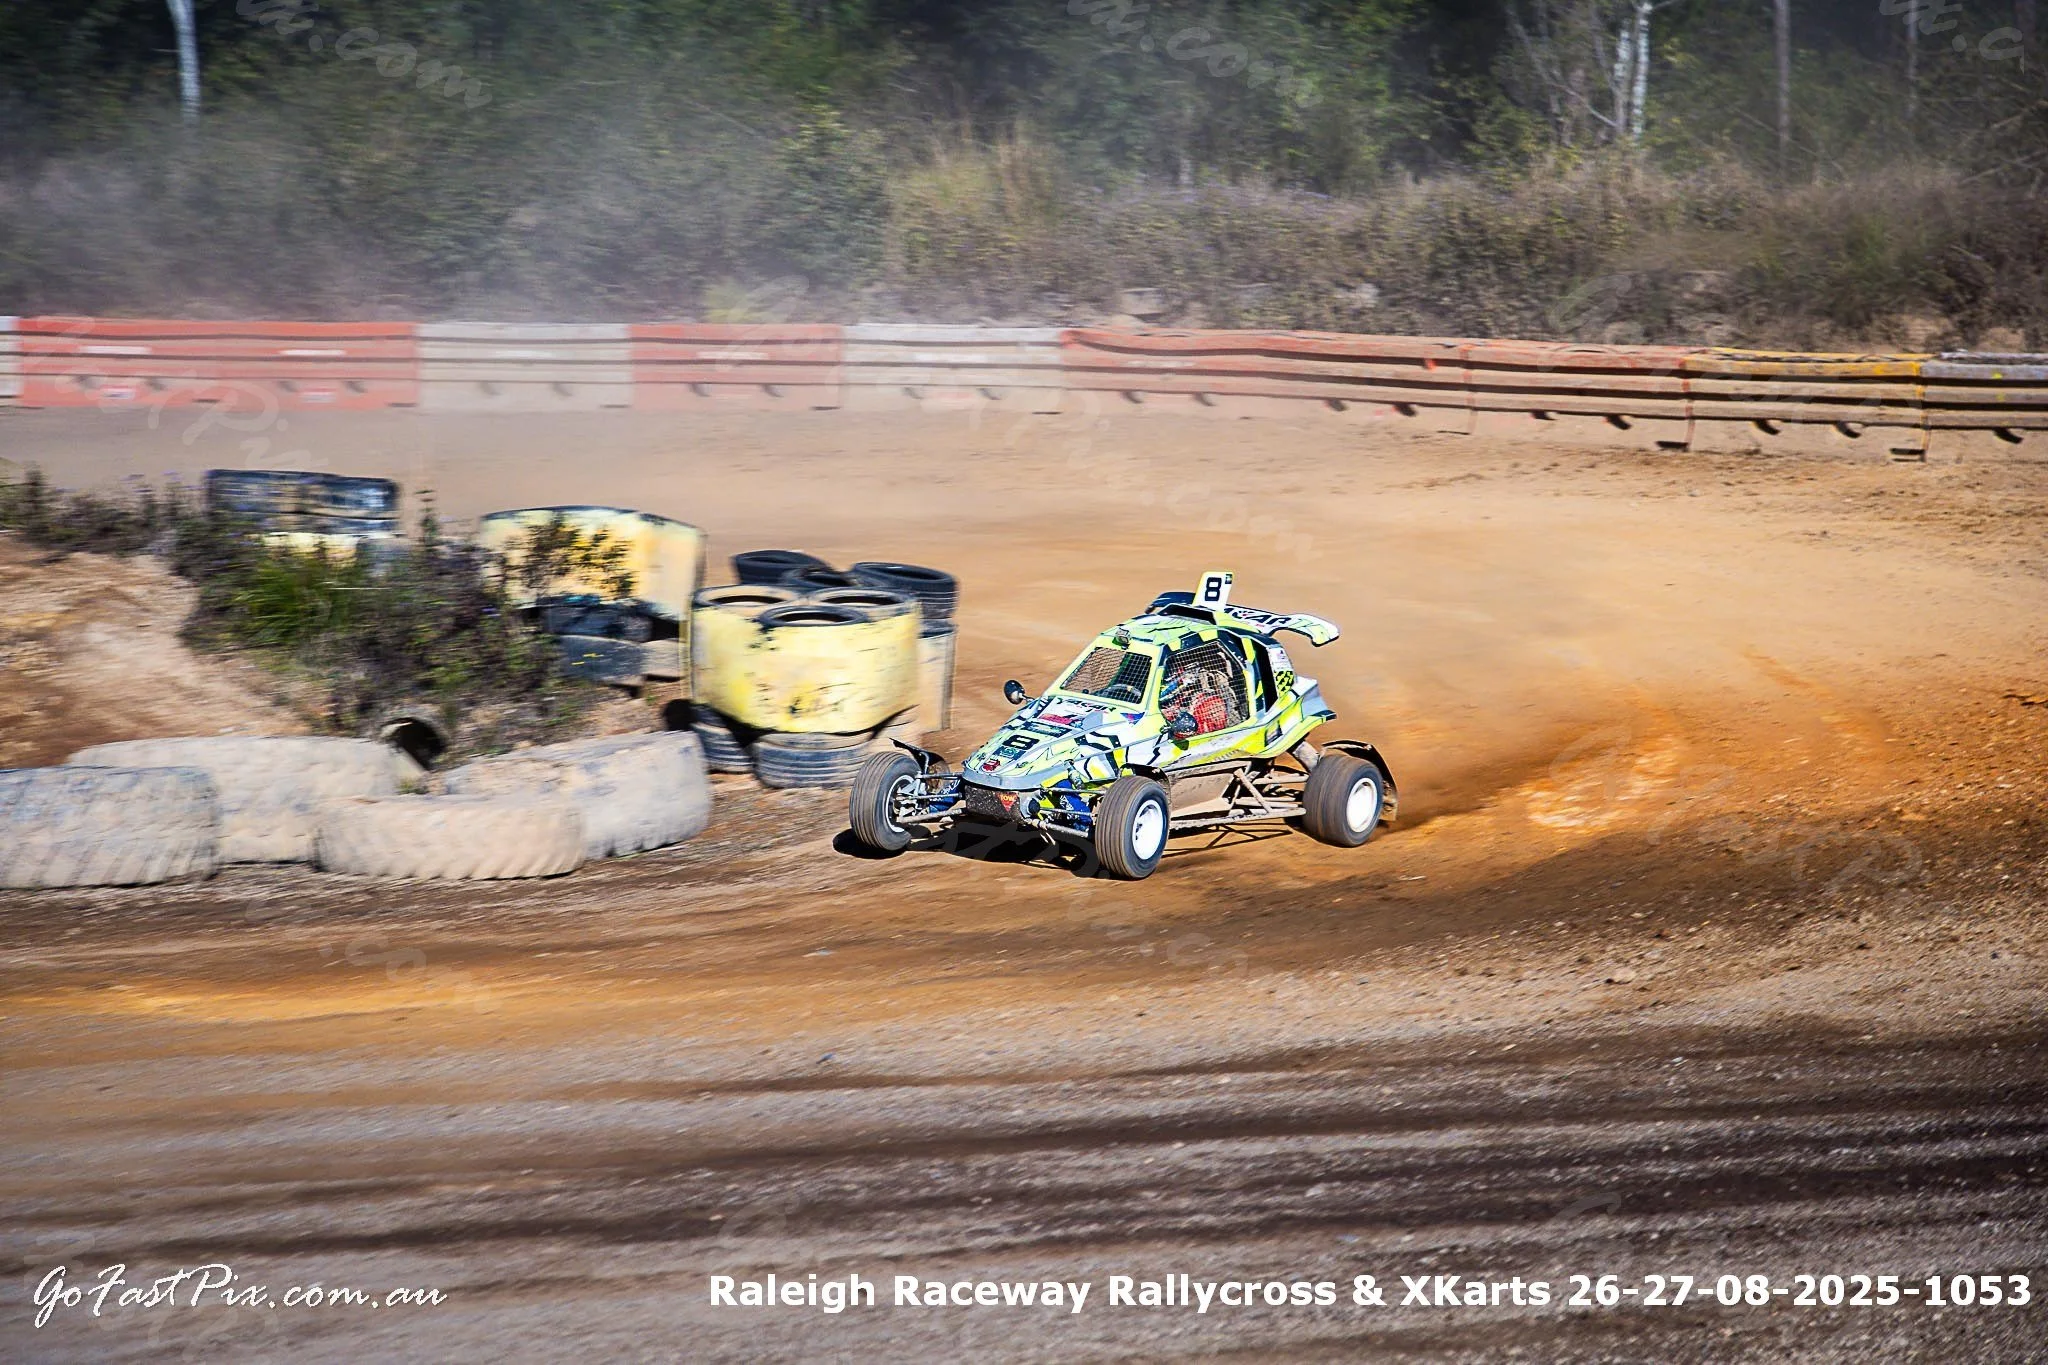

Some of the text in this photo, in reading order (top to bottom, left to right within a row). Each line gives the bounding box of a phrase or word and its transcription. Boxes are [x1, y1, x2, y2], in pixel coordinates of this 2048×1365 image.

[1204, 576, 1222, 602] 8
[1002, 734, 1040, 751] 8
[1000, 794, 1017, 802] TOW
